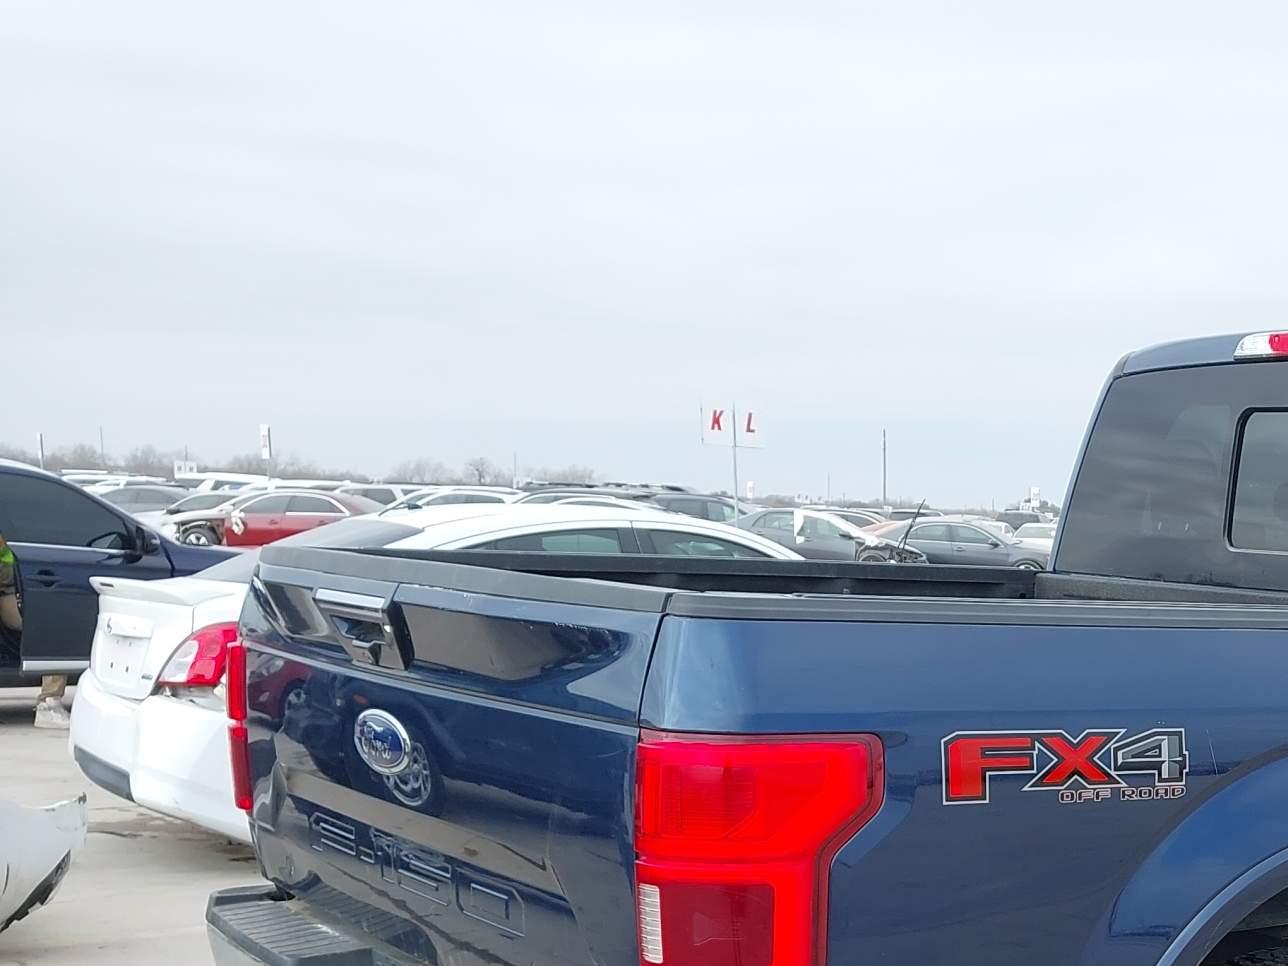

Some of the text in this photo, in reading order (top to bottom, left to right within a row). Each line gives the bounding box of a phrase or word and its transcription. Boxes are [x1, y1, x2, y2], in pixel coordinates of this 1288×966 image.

[711, 409, 724, 431] K
[746, 412, 756, 433] L
[358, 721, 392, 760] Ford
[941, 727, 1189, 806] FX4
[1058, 786, 1187, 804] OFF ROAD
